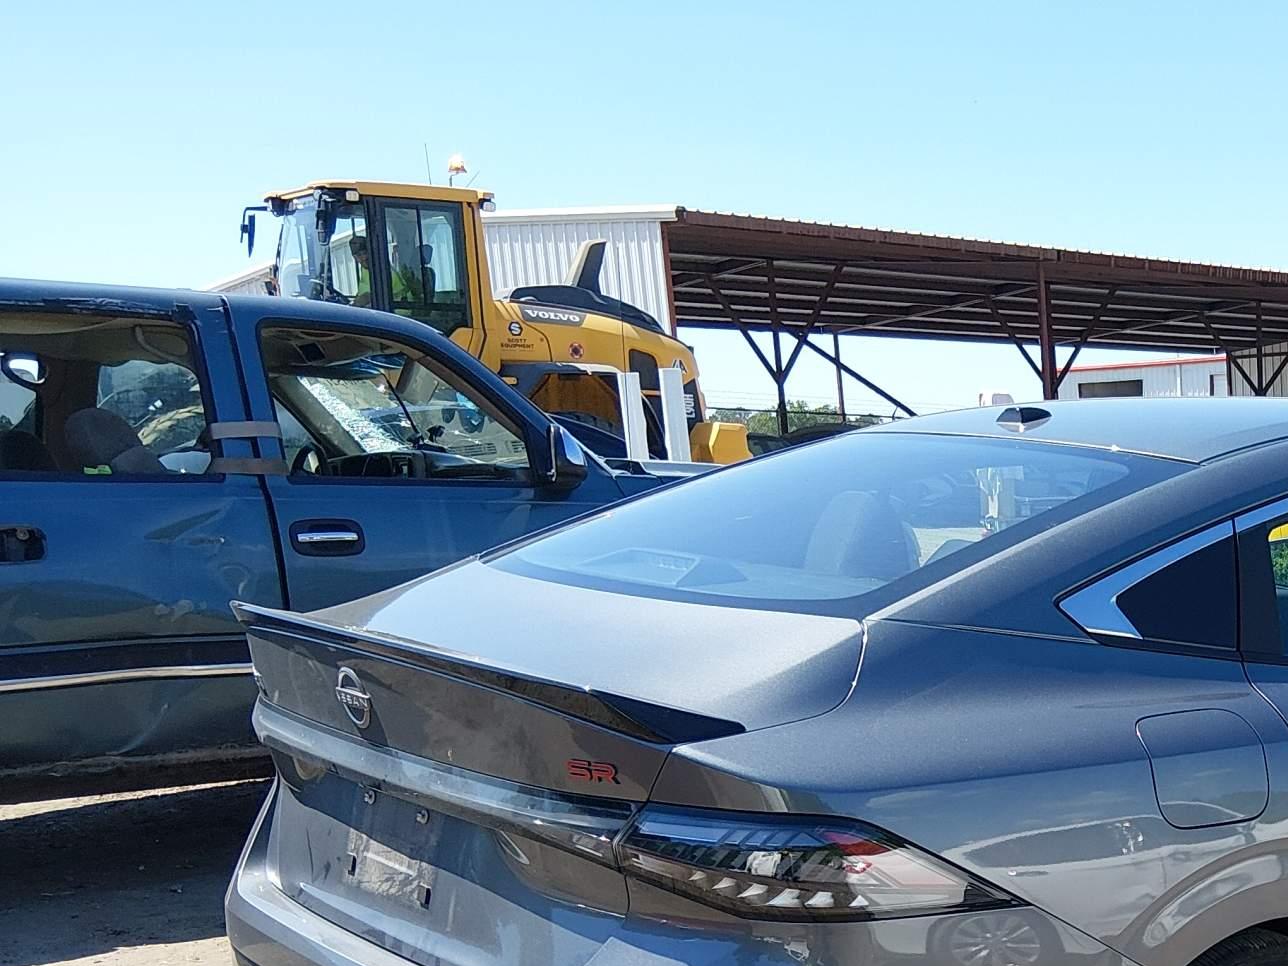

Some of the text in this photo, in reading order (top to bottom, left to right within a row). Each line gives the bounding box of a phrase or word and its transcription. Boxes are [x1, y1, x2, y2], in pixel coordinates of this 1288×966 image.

[523, 309, 580, 322] VOLVO
[336, 690, 368, 707] NSSAN
[567, 760, 617, 784] SR
